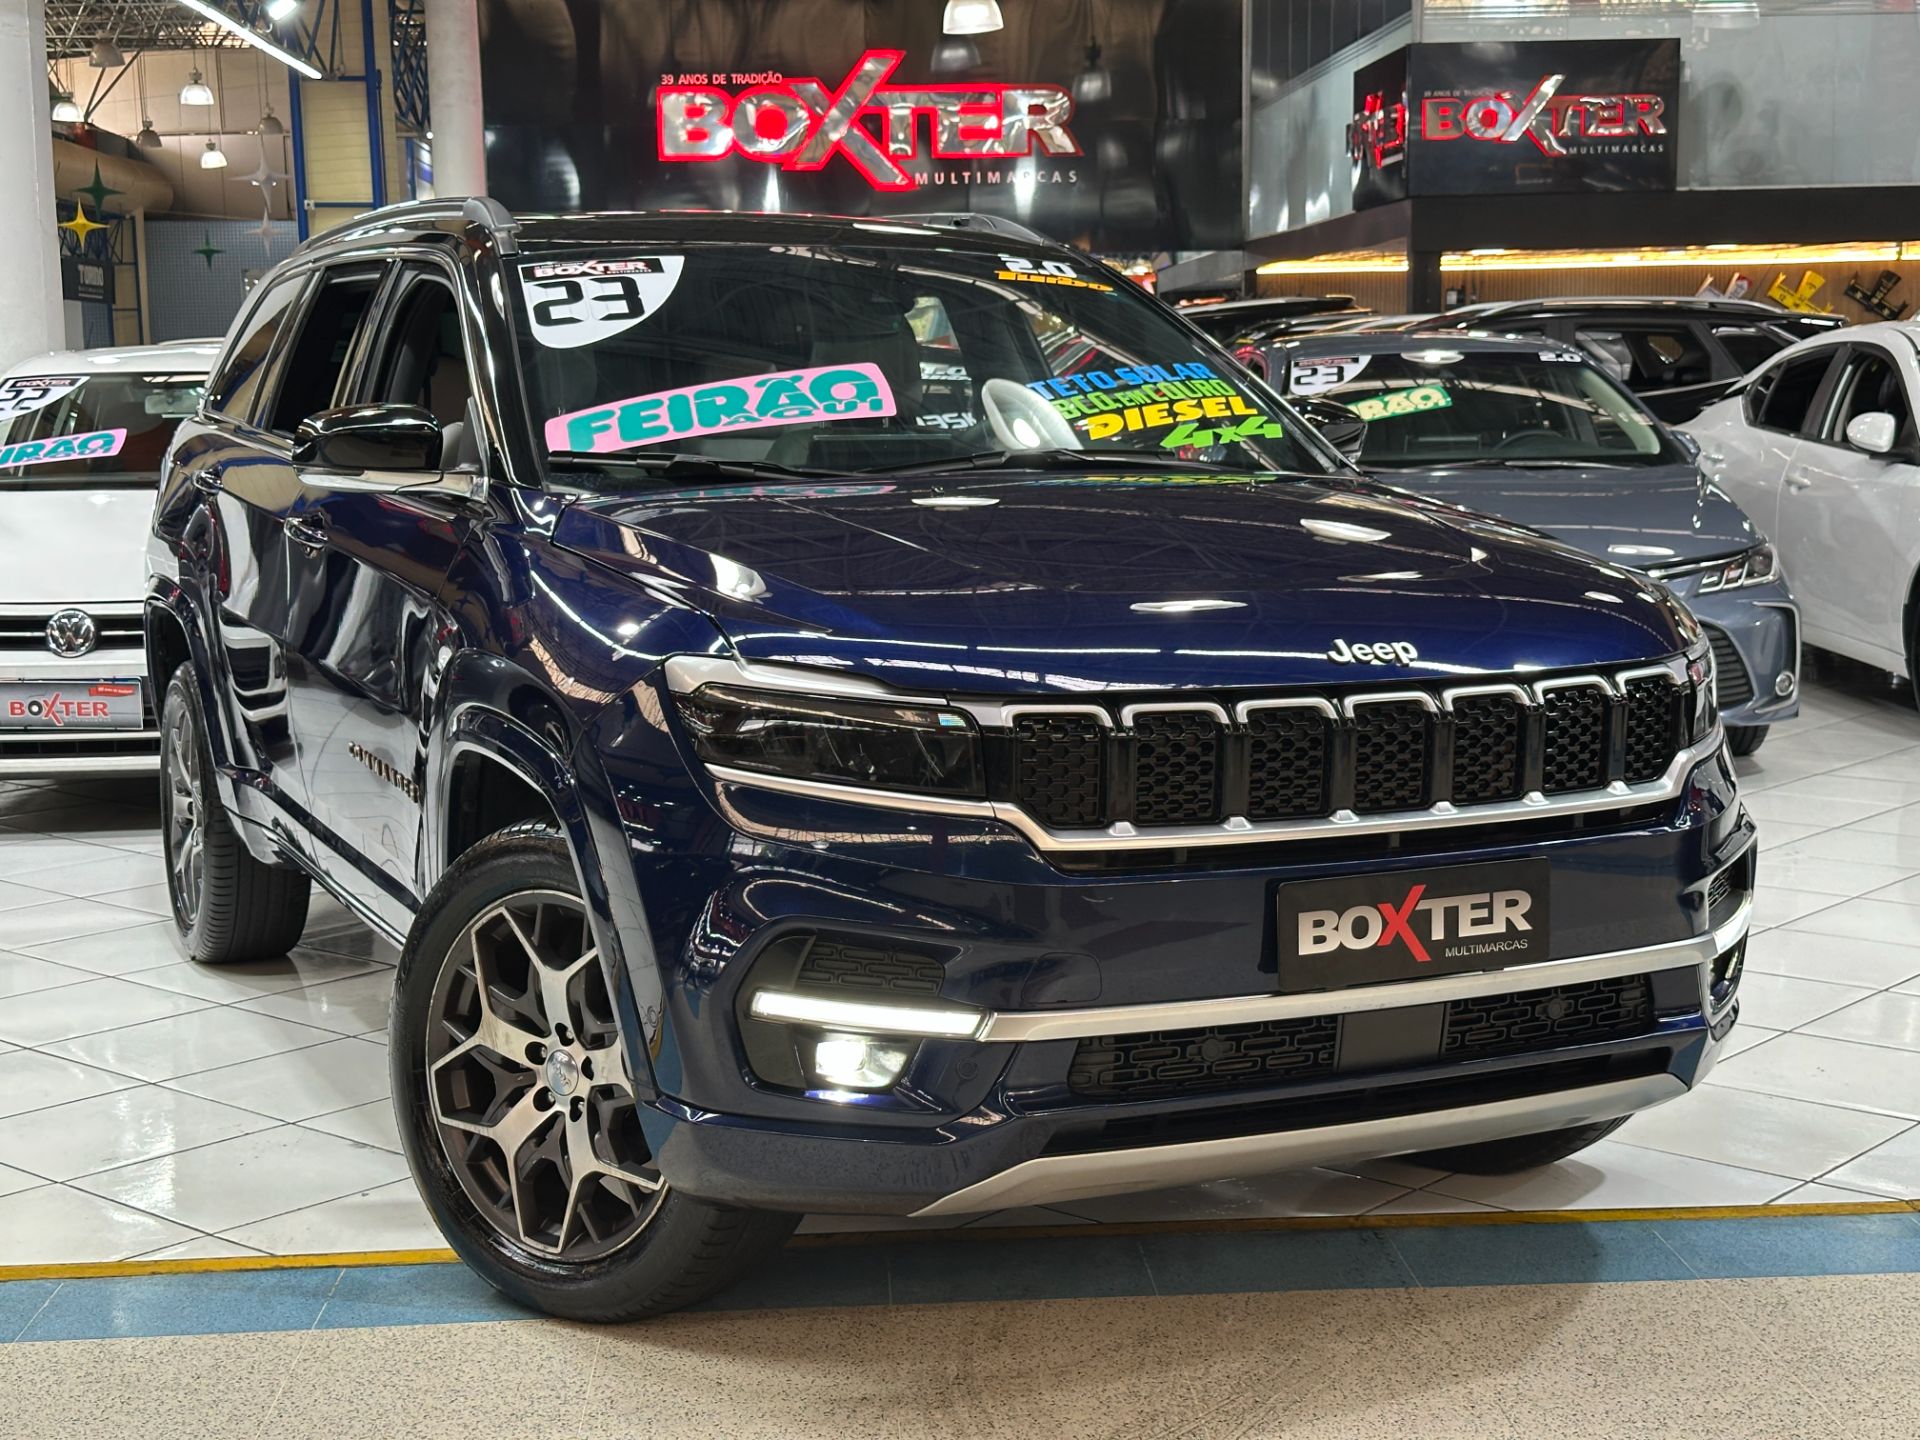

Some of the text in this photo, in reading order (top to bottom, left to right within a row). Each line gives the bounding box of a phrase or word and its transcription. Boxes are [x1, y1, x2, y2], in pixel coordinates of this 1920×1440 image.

[661, 71, 783, 85] 39 ANOS DE TRADIÇÃO
[657, 49, 1084, 192] BOXTER
[1421, 74, 1668, 158] BOXTER
[1568, 143, 1665, 155] MULTIMARCAS
[914, 170, 1078, 185] MULTIMARCAS
[533, 259, 652, 278] BOXTER
[999, 255, 1078, 279] 2.0
[533, 276, 645, 327] 23
[1539, 351, 1582, 362] 2.0
[15, 378, 72, 389] BOXTER
[1026, 362, 1219, 400] TETO SOLAR
[1294, 365, 1345, 386] 23
[1141, 379, 1237, 402] COURO
[567, 369, 880, 453] FEIRÃO
[1086, 396, 1258, 441] DIESEL
[1327, 639, 1418, 666] Jeep
[9, 692, 110, 726] BOXTER
[1298, 884, 1534, 962] BOXTER
[1445, 938, 1529, 958] MULTIMARCAS
